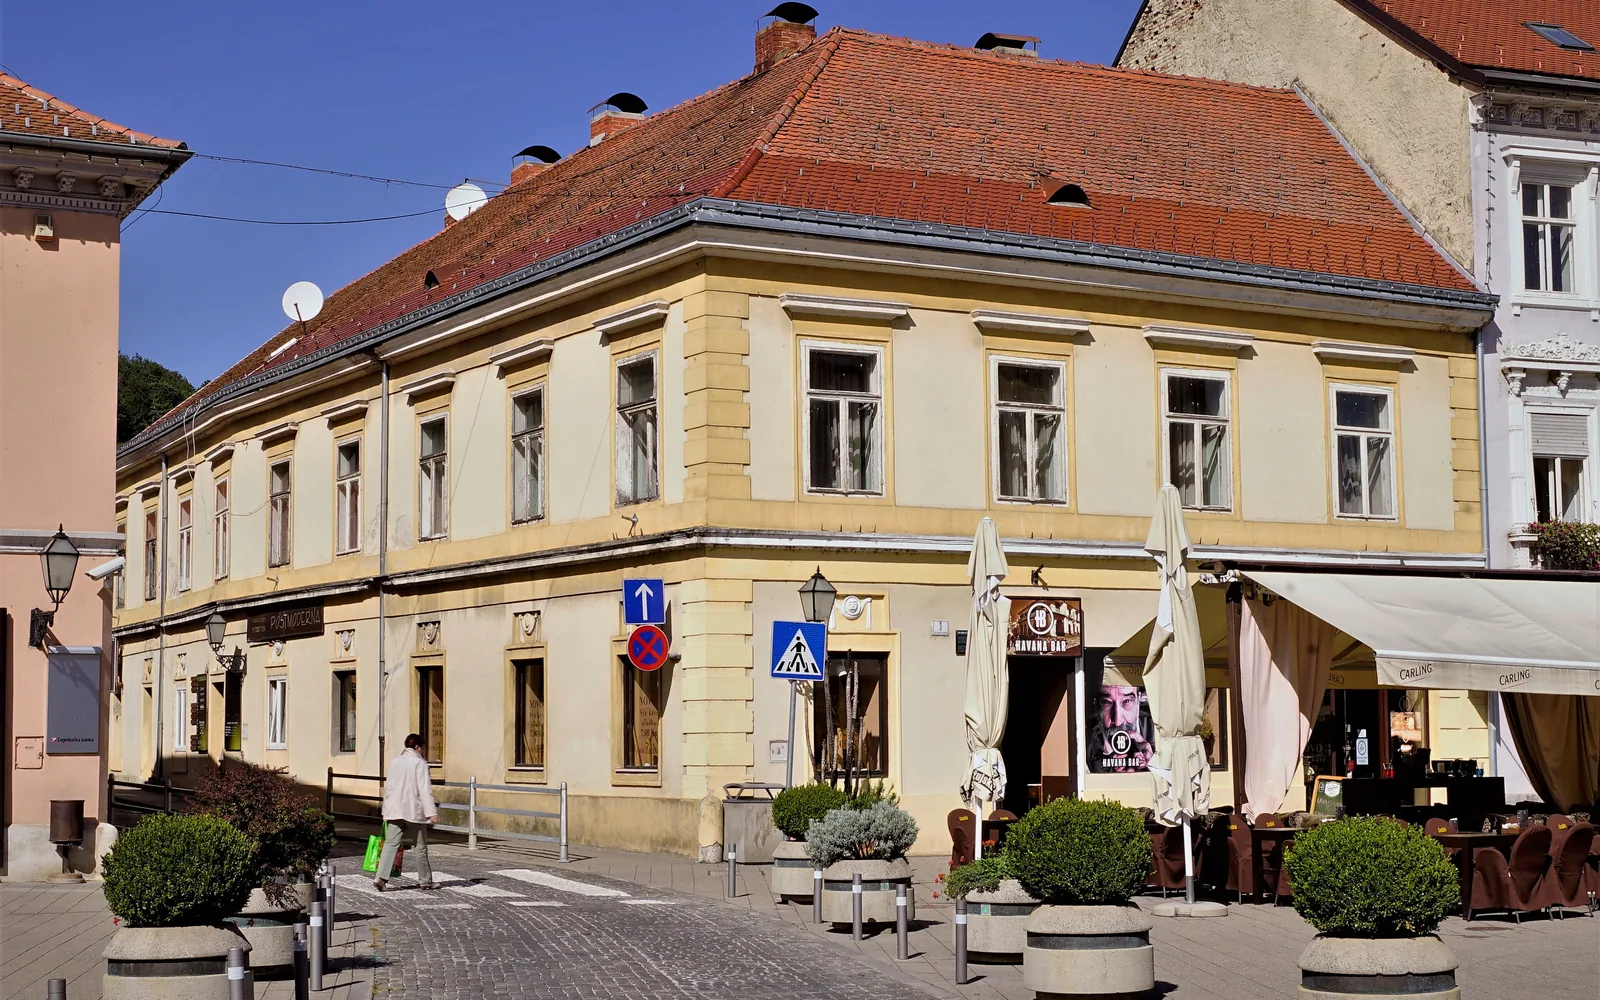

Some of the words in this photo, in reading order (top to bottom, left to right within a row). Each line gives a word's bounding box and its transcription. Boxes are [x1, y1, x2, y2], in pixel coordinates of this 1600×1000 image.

[1015, 640, 1047, 652] HAVANA
[1051, 640, 1067, 652] BAR
[1399, 663, 1433, 681] CARLING
[1499, 669, 1530, 686] CARLING
[1102, 758, 1127, 768] HAVANA
[1128, 758, 1140, 767] BAR
